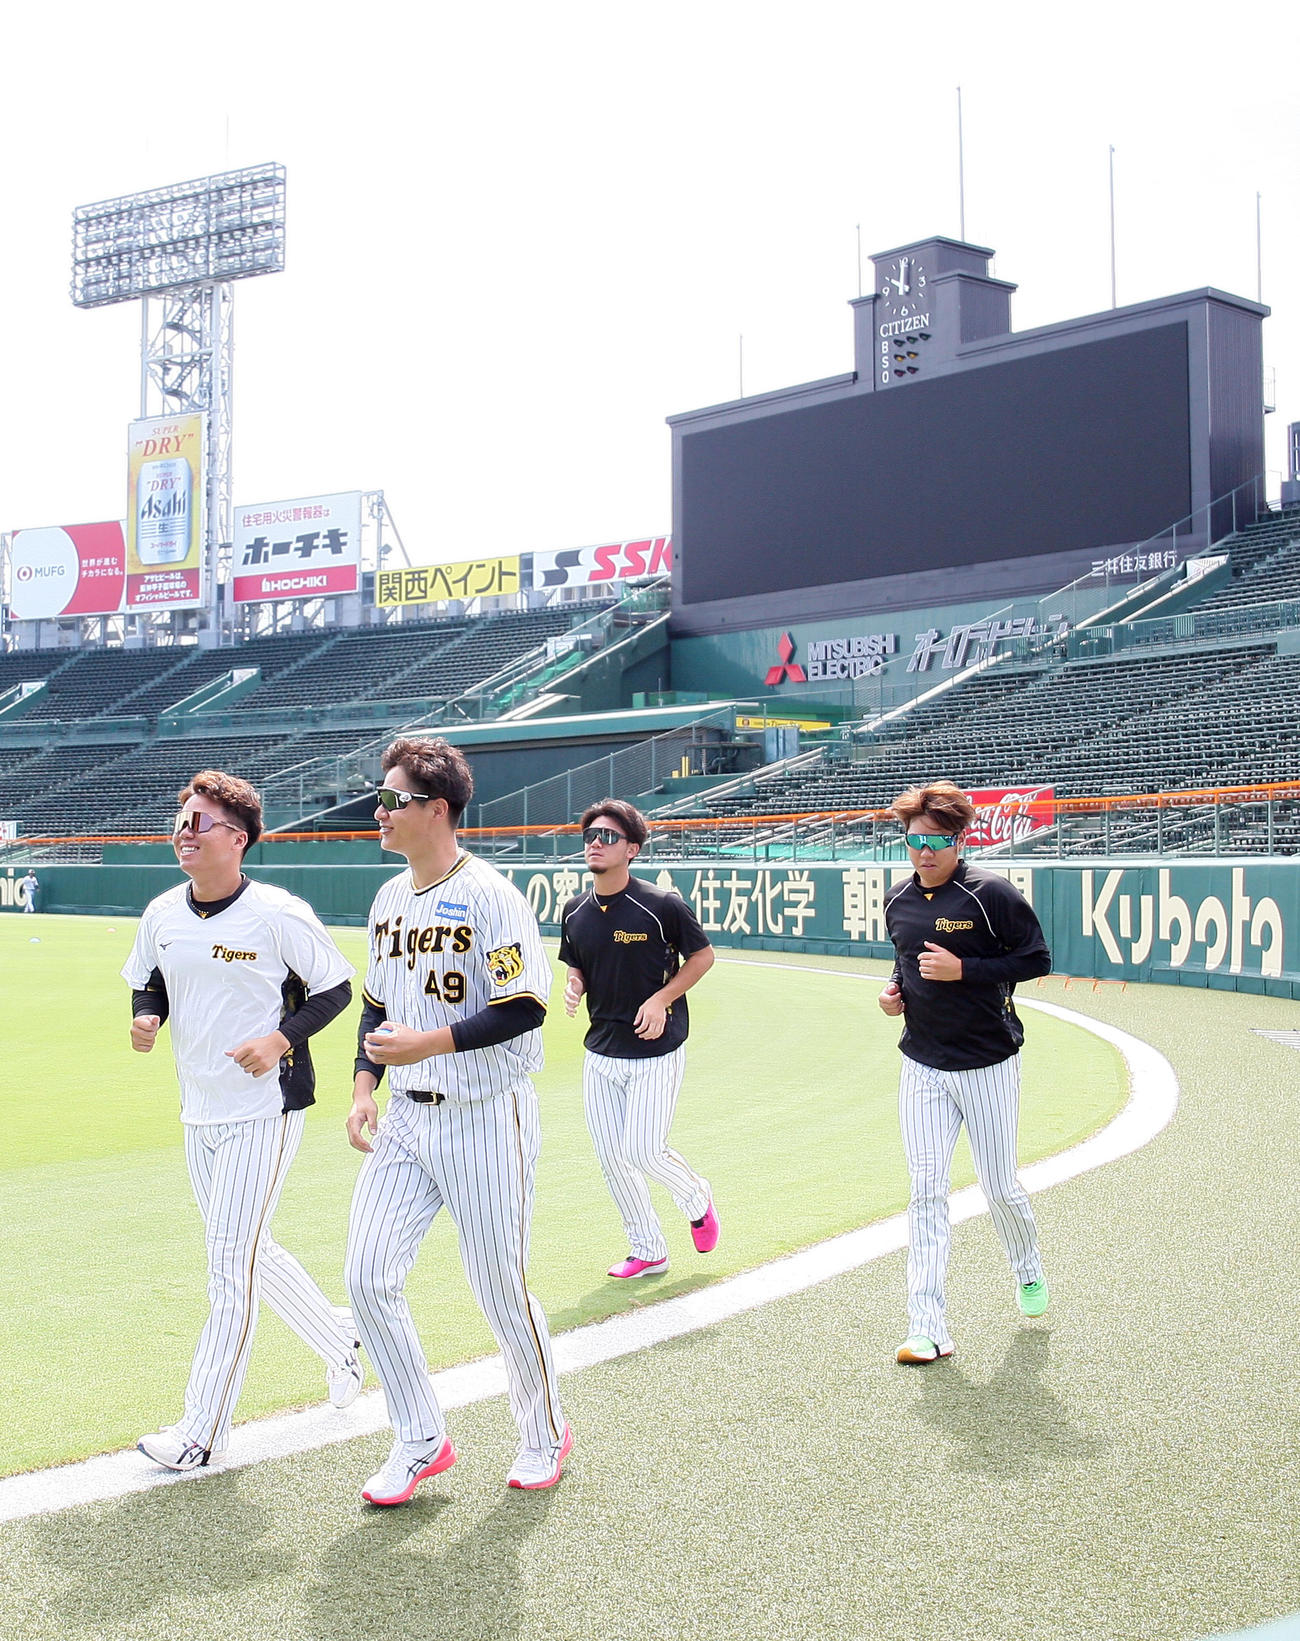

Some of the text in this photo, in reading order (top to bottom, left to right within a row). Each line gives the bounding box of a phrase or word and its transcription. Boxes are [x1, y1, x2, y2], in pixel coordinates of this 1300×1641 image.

[882, 286, 890, 297] 9
[918, 276, 926, 287] 3
[900, 306, 909, 317] 6
[880, 313, 930, 338] CITIZEN
[141, 489, 186, 519] Asahi
[242, 504, 331, 528] 住宅用火災警報器は
[157, 522, 169, 534] 生
[241, 528, 348, 565] ホーチキ
[34, 565, 65, 578] MUFG
[588, 538, 673, 581] SSK
[1090, 551, 1178, 577] 三井住友銀行
[271, 575, 327, 592] HOCHIKI
[378, 559, 517, 604] 関西ペイント
[807, 633, 896, 661] MITSUBISHI
[807, 656, 884, 682] ELECTRIC
[436, 903, 467, 918] Joshin
[691, 868, 816, 936] 住友化学
[935, 917, 974, 933] Tigers
[1081, 867, 1283, 978] Kubota
[375, 915, 473, 971] Tigers
[613, 929, 648, 944] Tigers
[211, 943, 257, 963] Tigers
[424, 970, 467, 1004] 49
